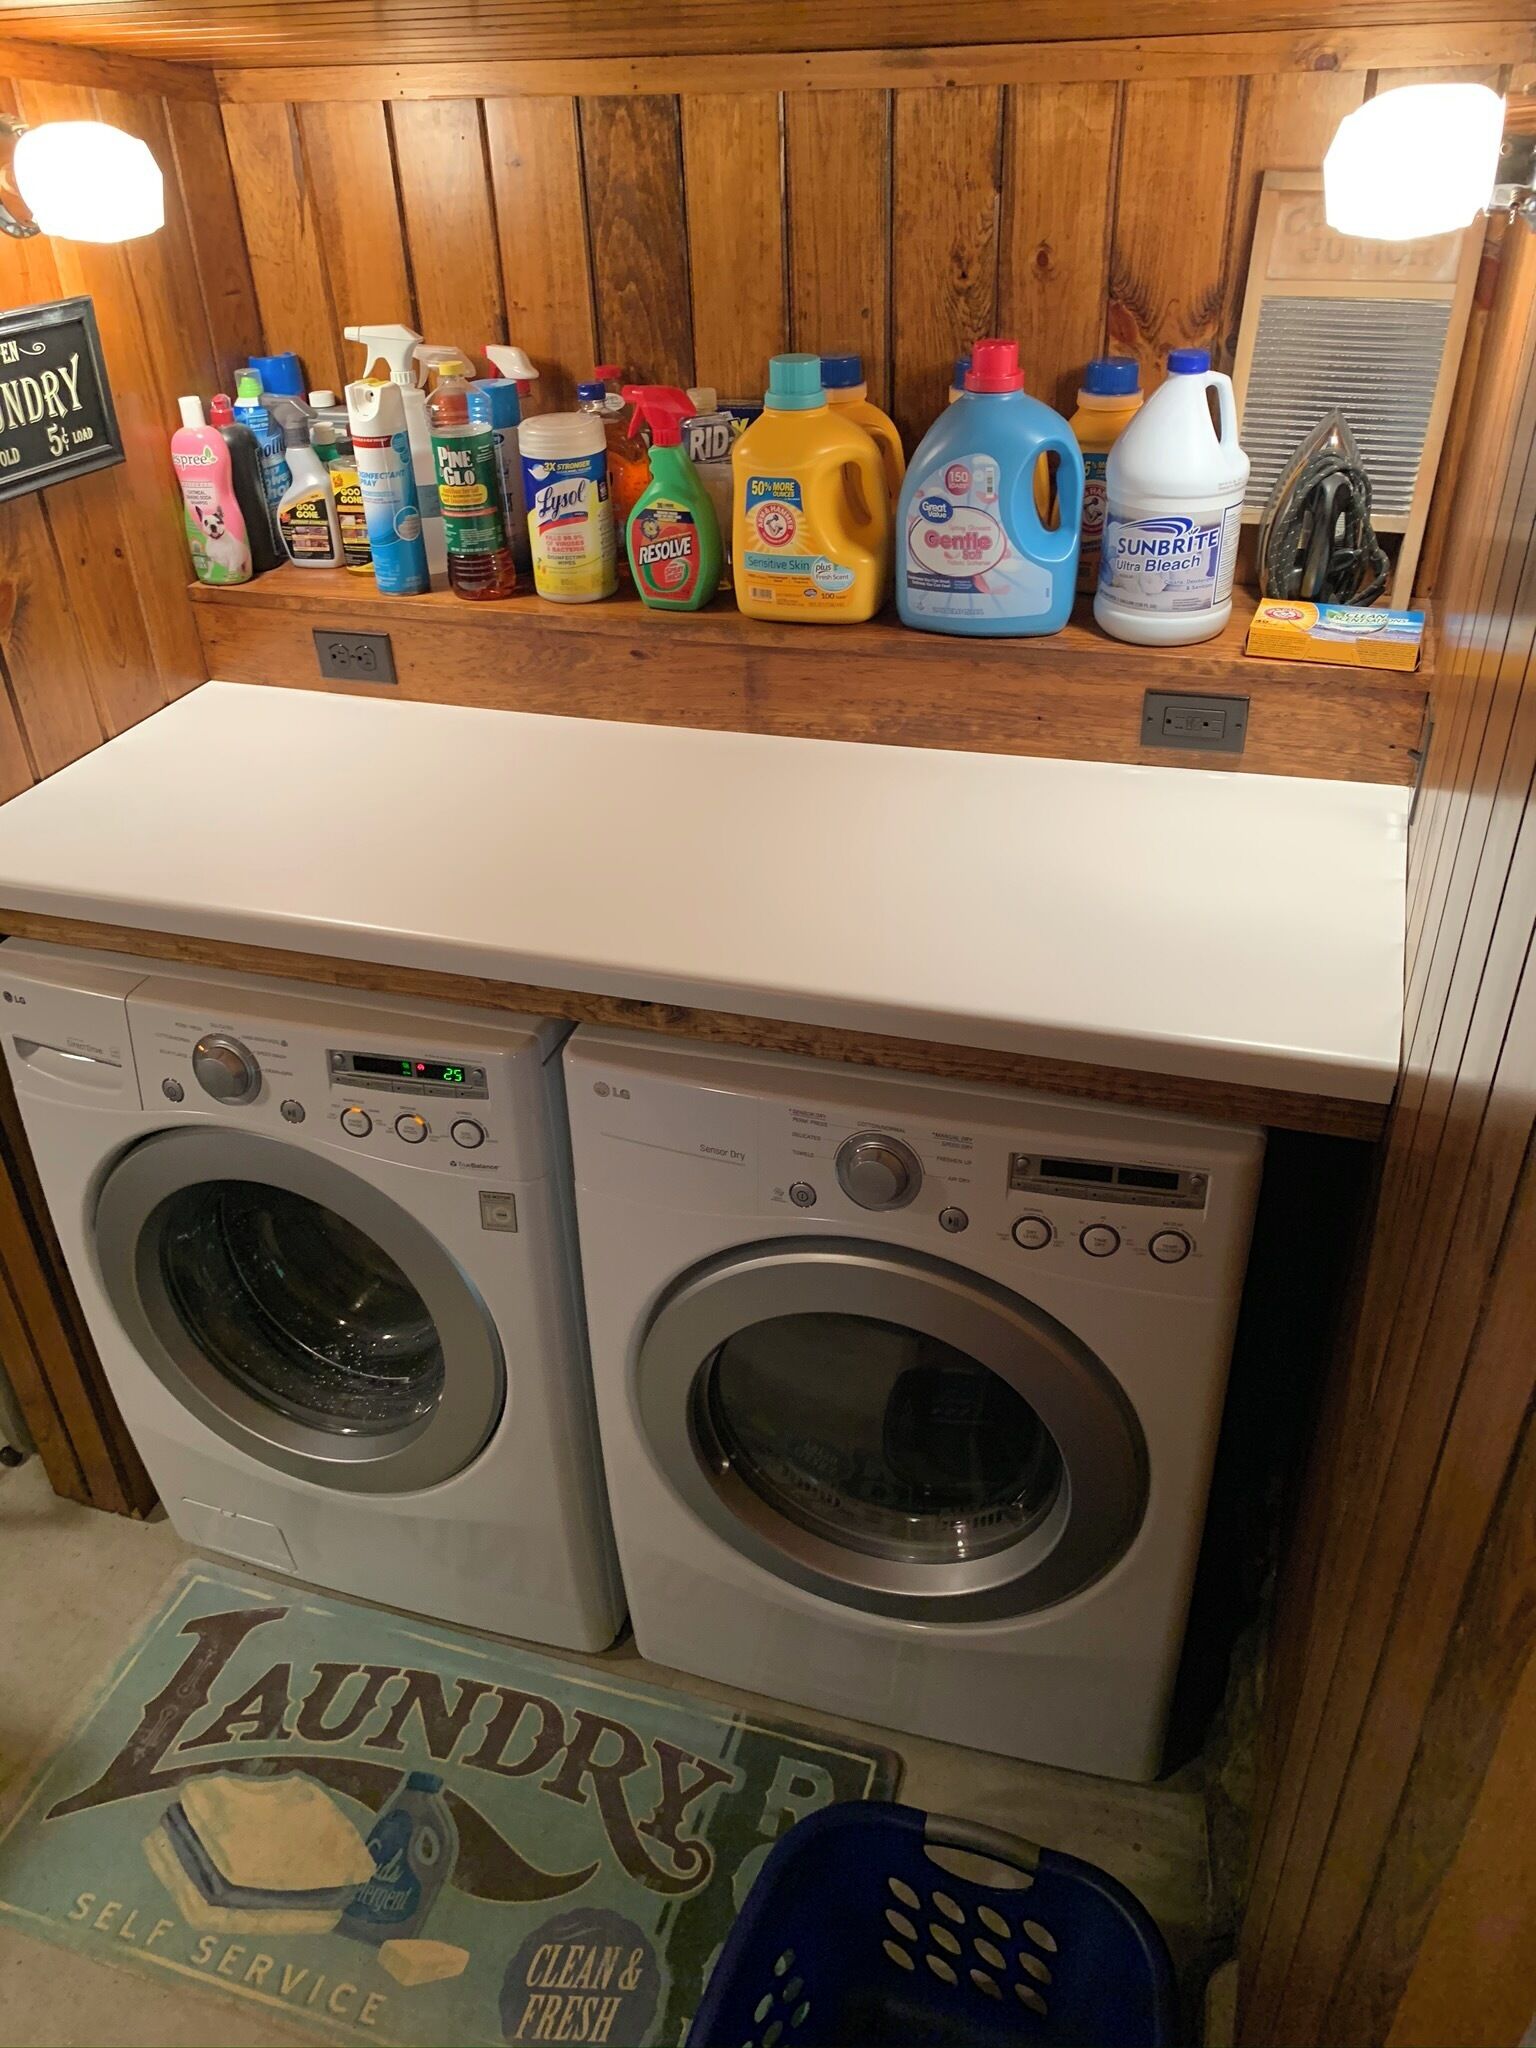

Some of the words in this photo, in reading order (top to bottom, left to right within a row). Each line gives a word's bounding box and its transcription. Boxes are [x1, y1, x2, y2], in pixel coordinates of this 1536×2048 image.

[0, 341, 20, 364] EN
[72, 426, 94, 444] LOAD
[0, 447, 20, 467] OLD
[437, 446, 473, 468] PINE
[543, 462, 556, 472] 3X
[556, 460, 591, 471] STRONGER
[443, 466, 476, 486] GLO
[949, 471, 969, 482] 150
[340, 488, 361, 496] GOO
[751, 480, 772, 496] 50%
[772, 482, 795, 491] MORE
[296, 503, 316, 511] GOO
[537, 479, 586, 519] Lysol
[922, 501, 947, 513] Great
[296, 511, 319, 519] GONE
[928, 510, 947, 519] Value
[924, 530, 993, 550] Gentle
[1117, 528, 1219, 556] SUNBRITE
[639, 537, 691, 565] RESOLVE
[748, 556, 788, 570] Sensitive
[788, 560, 810, 571] Skin
[815, 562, 832, 572] plus
[1116, 560, 1141, 572] Ultra
[1144, 555, 1201, 572] Bleach
[14, 995, 26, 1005] LG
[443, 1067, 463, 1082] 25
[612, 1087, 631, 1099] LG
[700, 1144, 729, 1156] Sensor
[730, 1150, 746, 1161] Dry
[45, 1607, 734, 1903] LAUNDRY
[67, 1892, 175, 1946] SELF
[525, 1944, 620, 1990] CLEAN
[618, 1948, 644, 1991] &
[190, 1934, 387, 2026] SERVICE
[514, 1994, 623, 2043] FRESH
